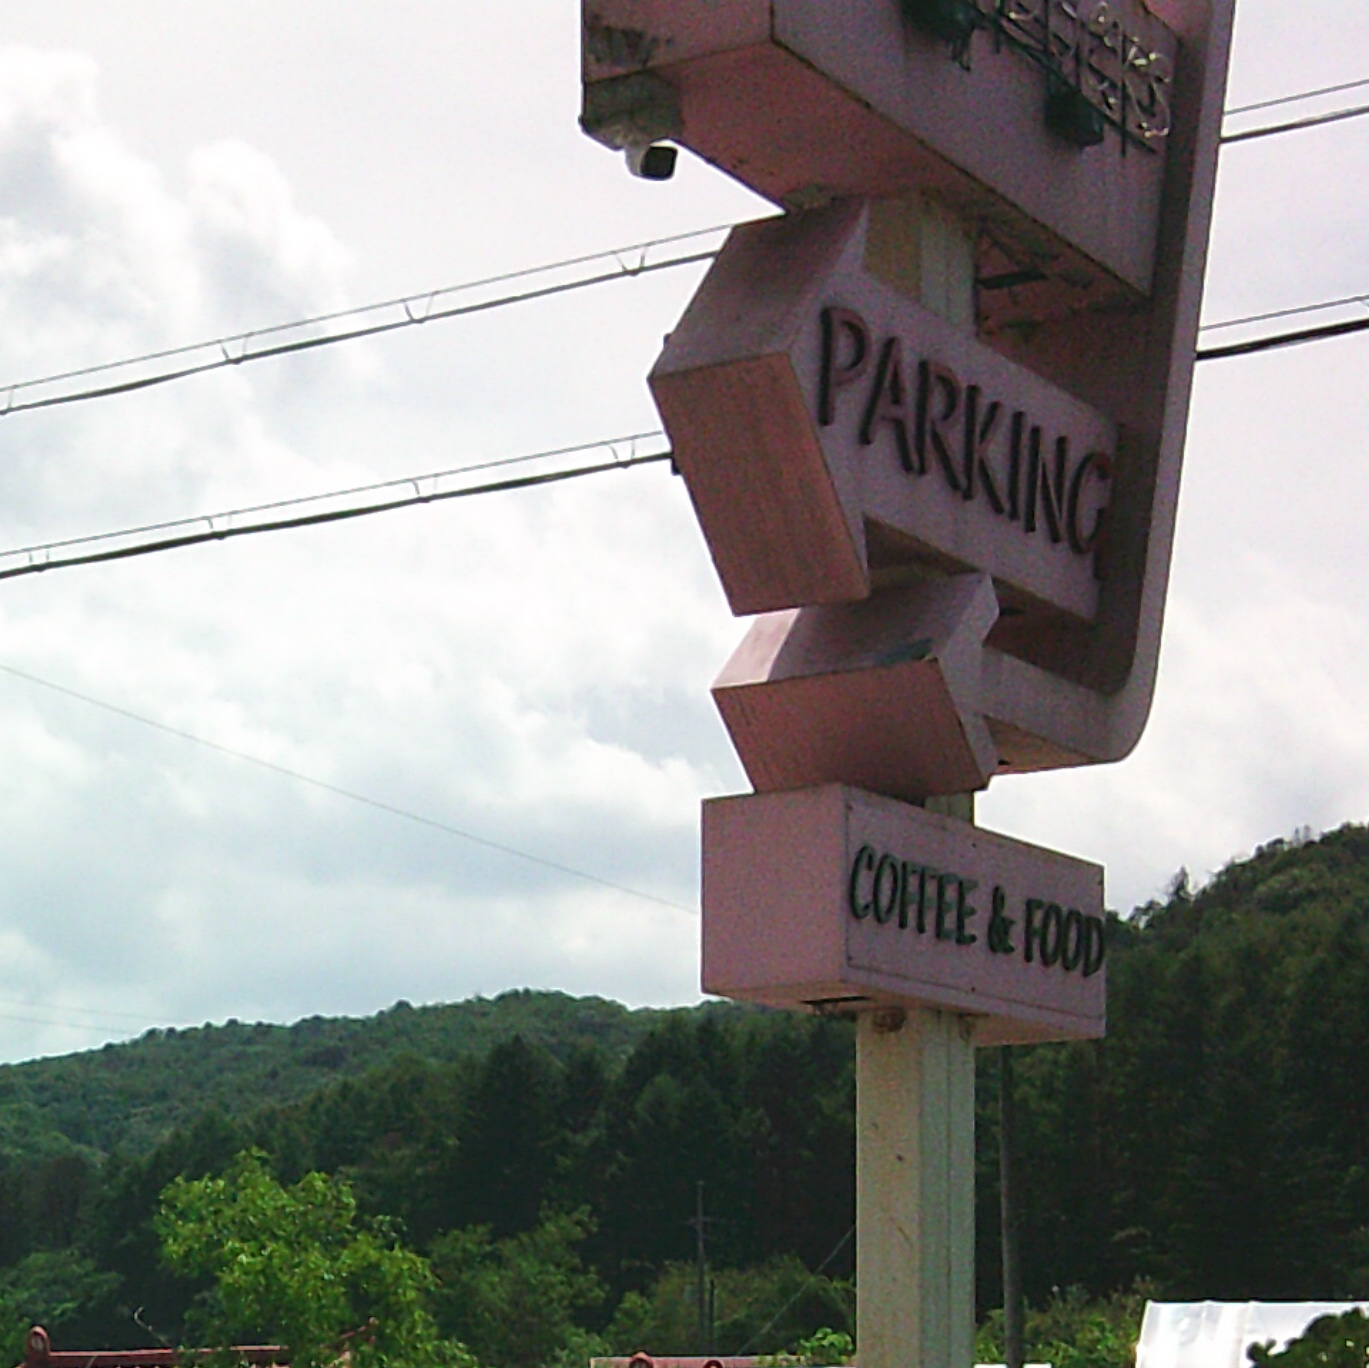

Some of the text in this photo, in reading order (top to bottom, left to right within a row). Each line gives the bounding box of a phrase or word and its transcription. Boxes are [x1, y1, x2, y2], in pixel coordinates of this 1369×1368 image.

[815, 305, 1113, 555] PARKING
[849, 844, 1106, 978] COFFEE & FOOD
